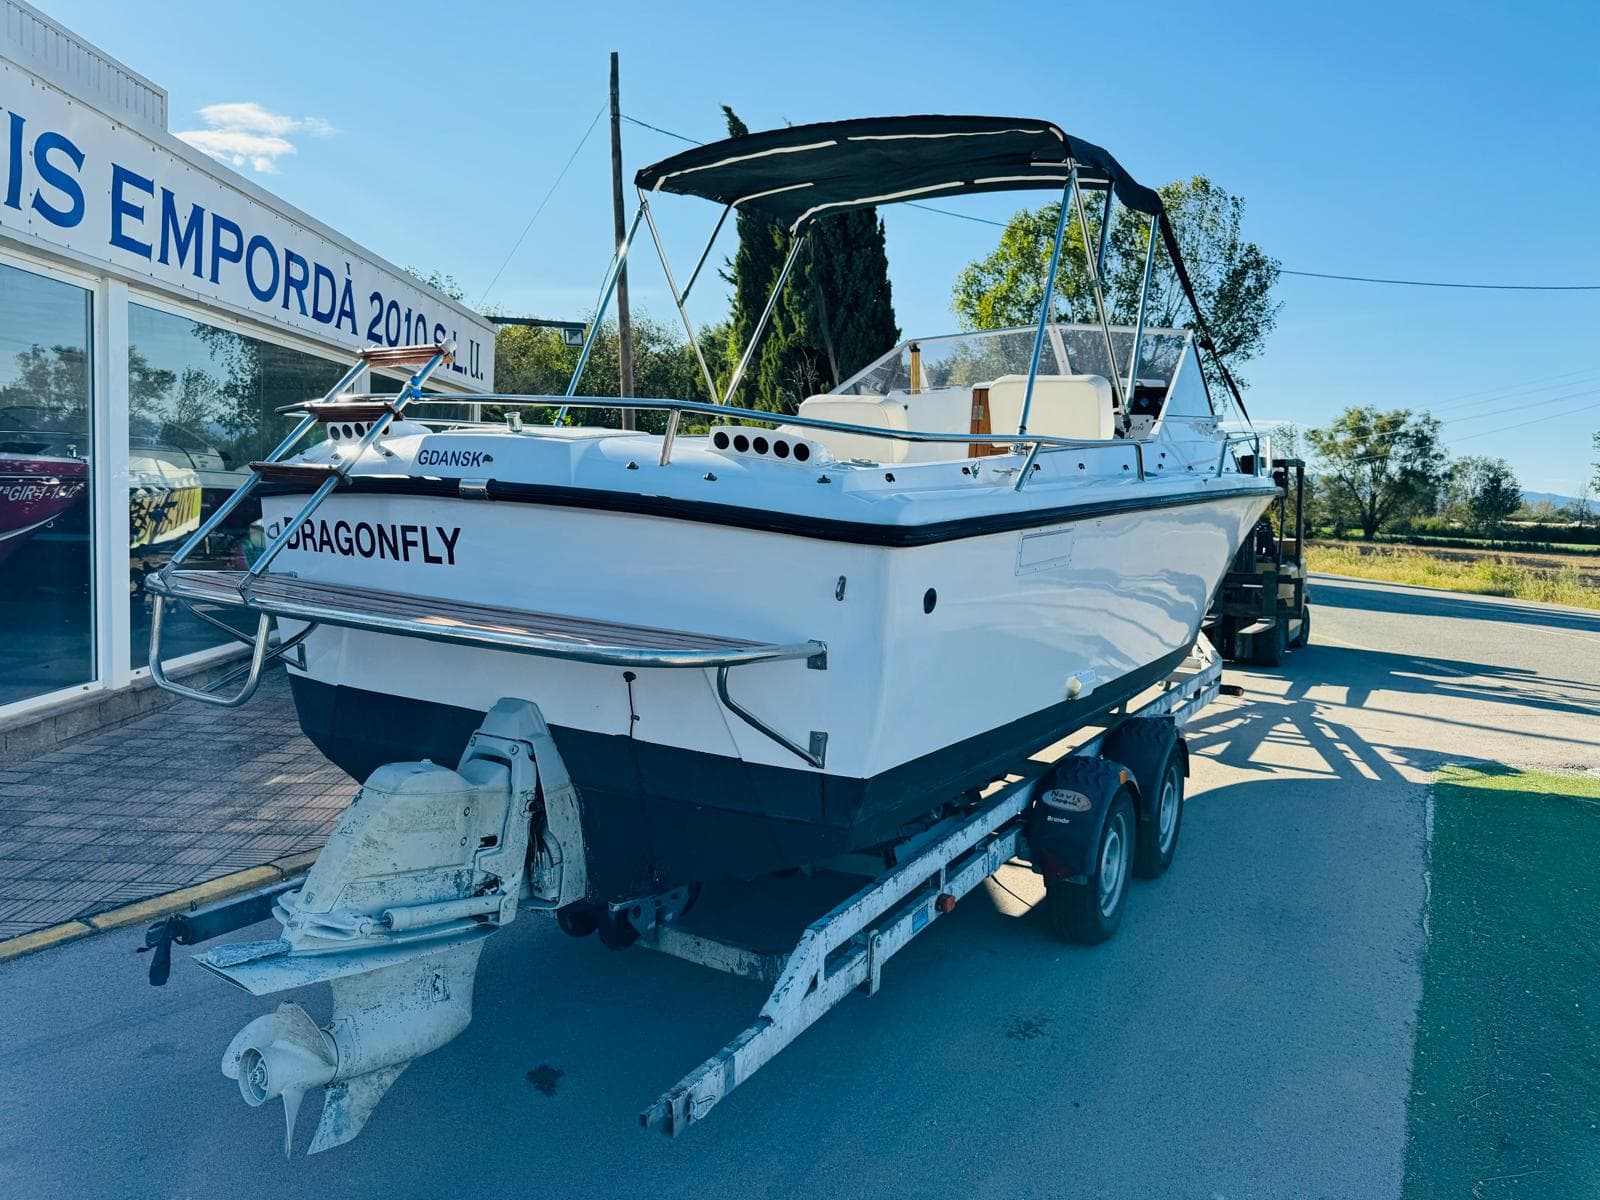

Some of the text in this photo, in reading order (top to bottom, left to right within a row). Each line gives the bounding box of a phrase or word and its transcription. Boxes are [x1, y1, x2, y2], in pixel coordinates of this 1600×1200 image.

[109, 162, 358, 336] EMPORDÀ
[367, 291, 427, 347] 2010
[418, 449, 483, 467] GDANSK
[284, 516, 461, 565] DRAGONFLY
